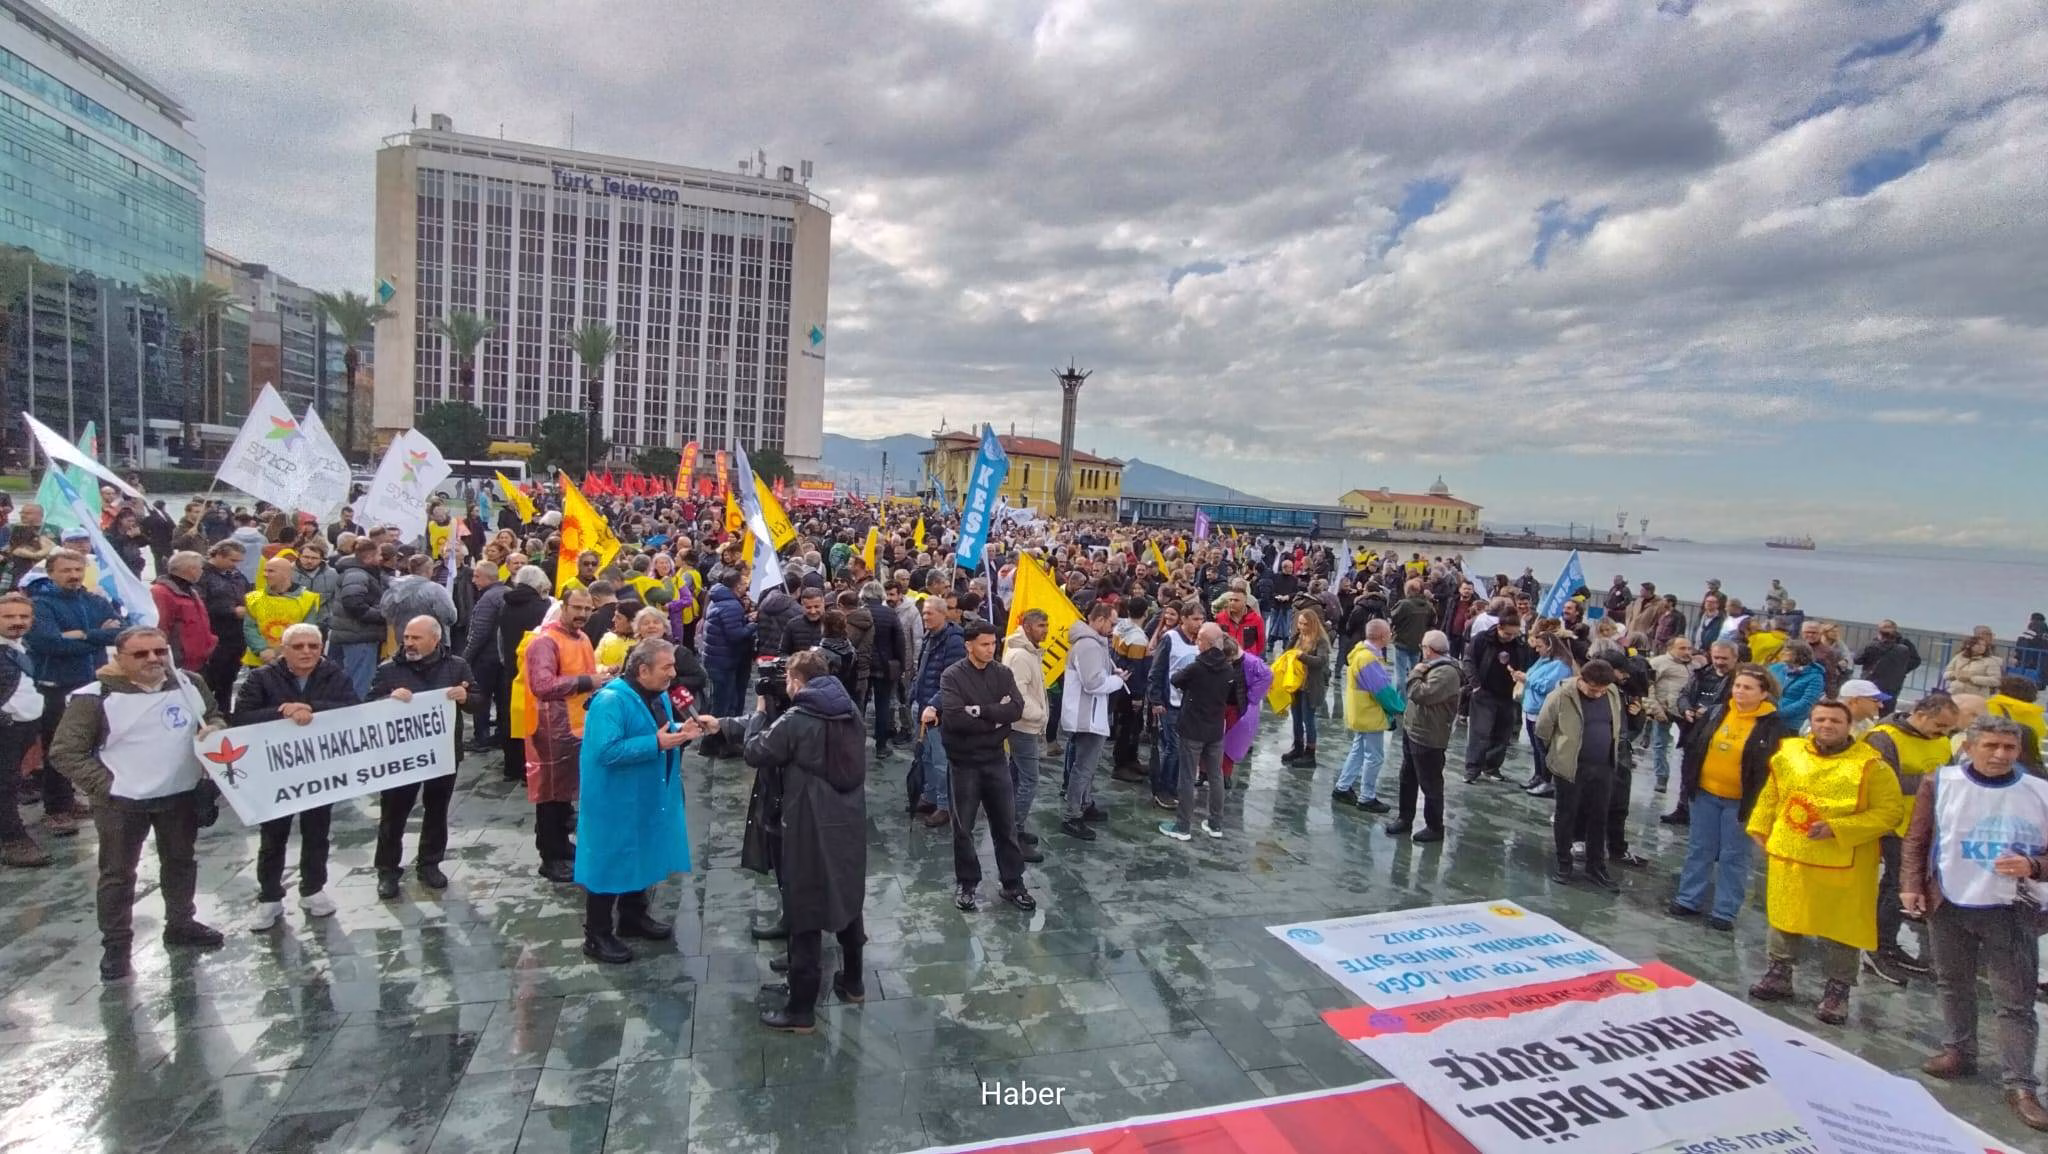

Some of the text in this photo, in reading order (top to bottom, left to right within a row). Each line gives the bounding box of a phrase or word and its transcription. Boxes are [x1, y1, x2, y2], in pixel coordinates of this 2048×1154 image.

[551, 169, 679, 201] Türk Telekom
[957, 464, 995, 559] KESK
[264, 704, 447, 773] İNSAN HAKLARI DERNEĞİ
[273, 748, 437, 804] AYDIN ŞUBESİ
[1470, 933, 1575, 955] YARARINA
[1428, 1009, 1743, 1091] EMEKÇİYE BÜTÇE
[1456, 1049, 1772, 1145] MAYEYE DEĞİL,
